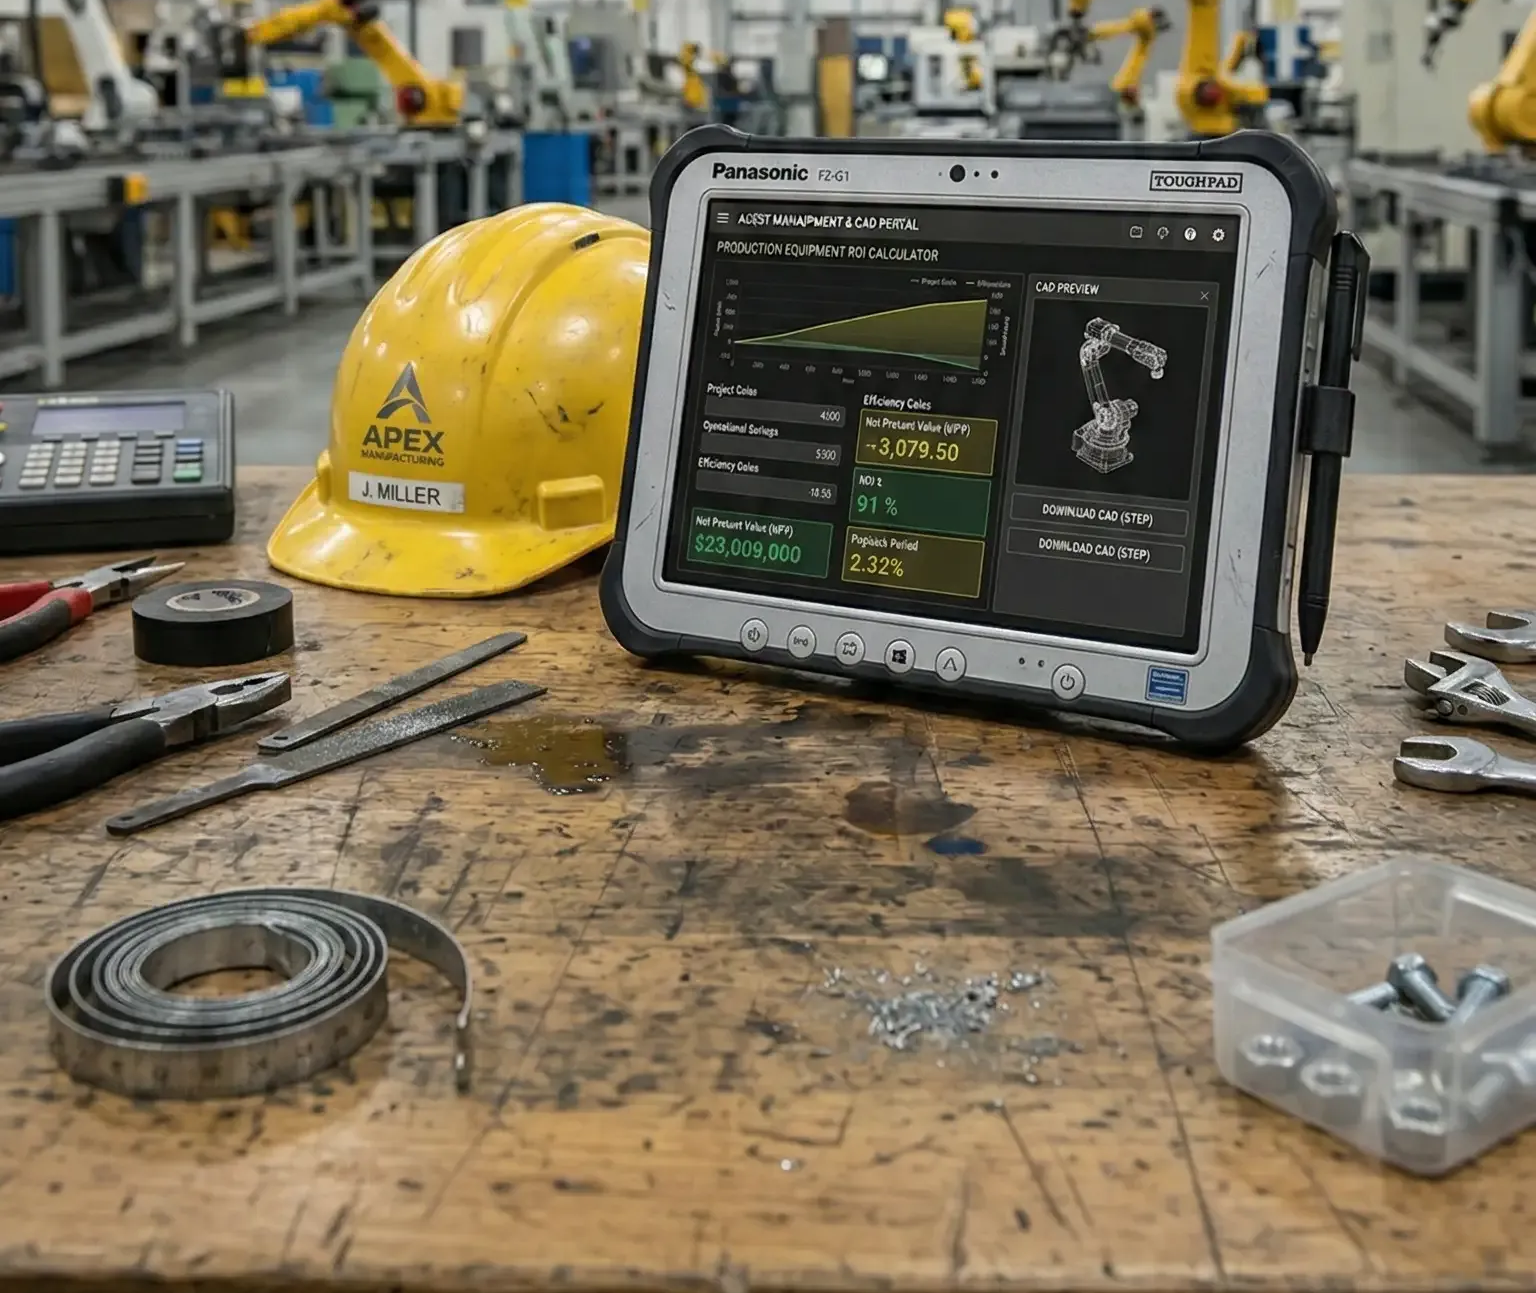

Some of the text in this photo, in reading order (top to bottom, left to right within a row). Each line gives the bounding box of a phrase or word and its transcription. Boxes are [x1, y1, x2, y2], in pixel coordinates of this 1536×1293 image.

[712, 162, 808, 181] Panasonic
[1154, 175, 1238, 189] TOUGHPAD
[855, 216, 877, 229] CAD
[717, 241, 938, 262] PRODUCTION EQUIPMENT ROI CALCULATOR
[1036, 281, 1099, 296] CAD PREVIEW
[707, 383, 734, 397] Project
[362, 425, 445, 455] APEX
[362, 480, 441, 506] J. MILLER
[857, 494, 898, 516] 91 %
[1098, 509, 1118, 522] CAD
[1120, 511, 1153, 528] (STEP)
[695, 533, 801, 564] $23,009,000
[1095, 544, 1116, 557] CAD
[1117, 546, 1151, 564] (STEP)
[850, 553, 904, 577] 2.32%
